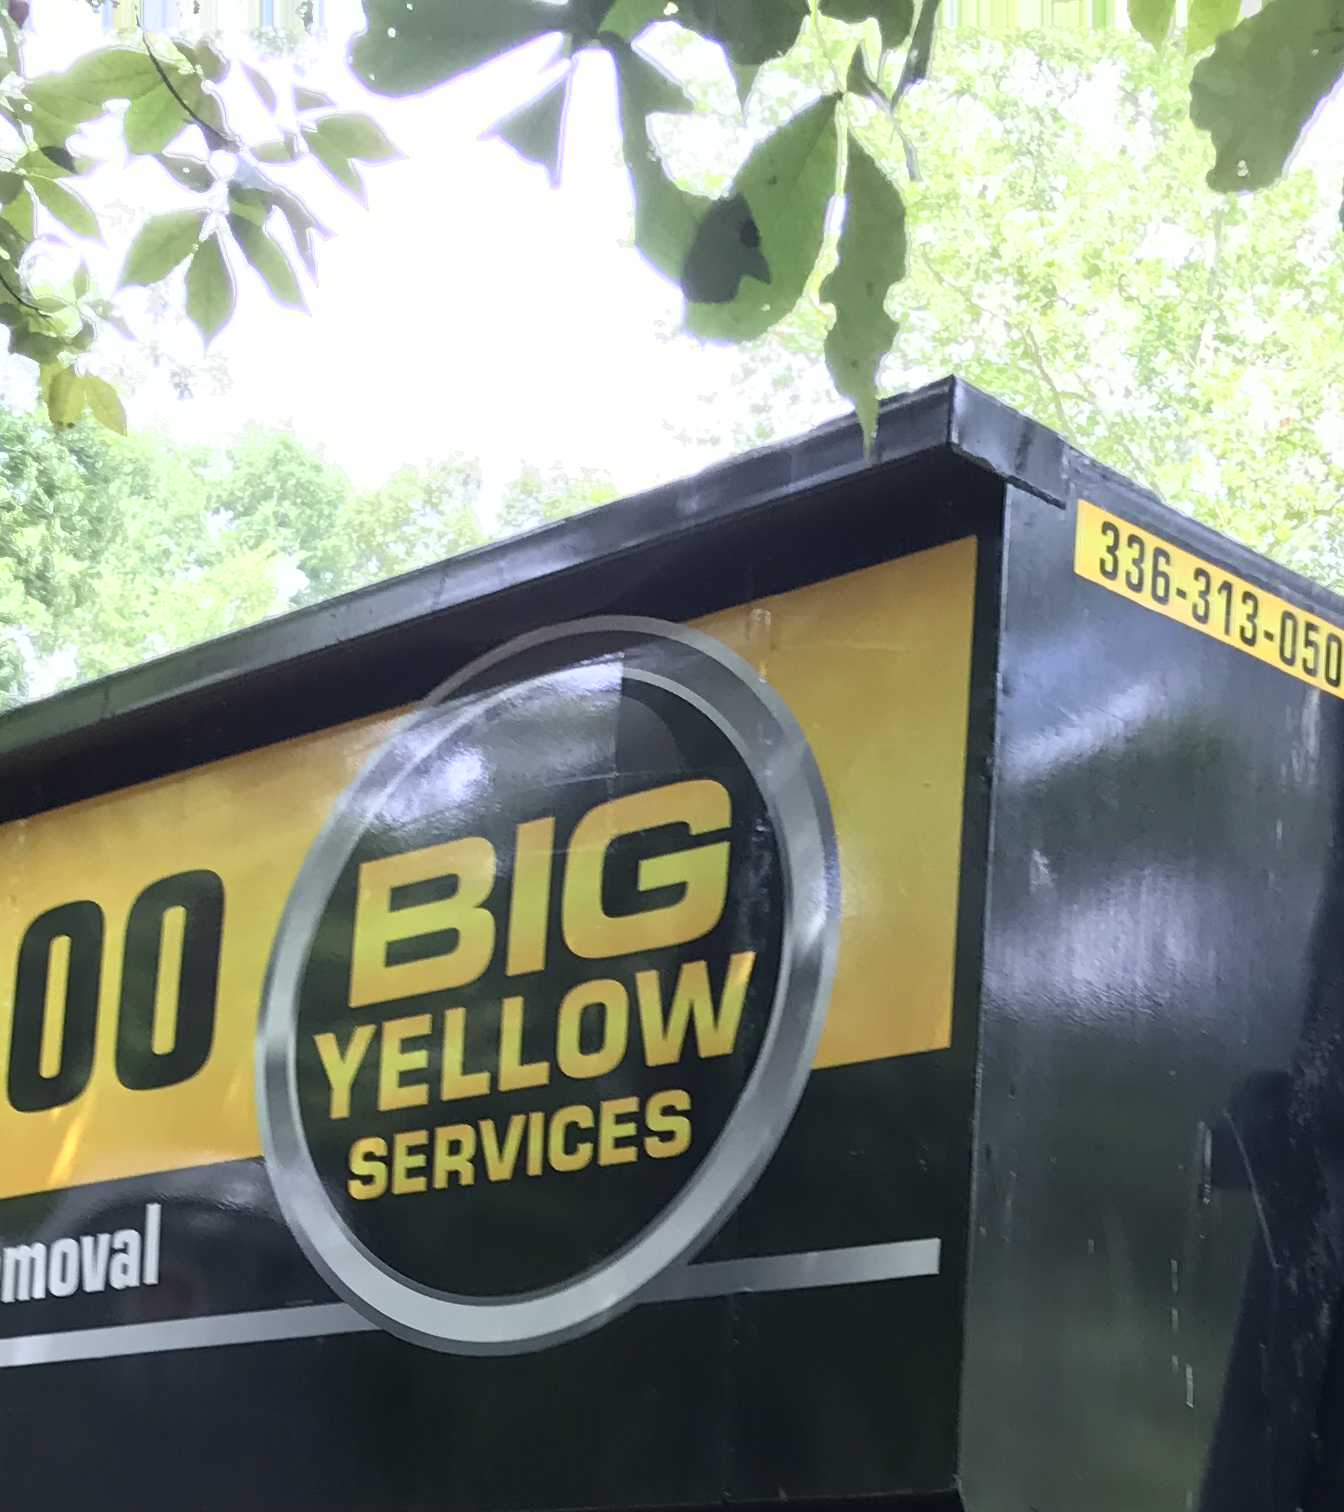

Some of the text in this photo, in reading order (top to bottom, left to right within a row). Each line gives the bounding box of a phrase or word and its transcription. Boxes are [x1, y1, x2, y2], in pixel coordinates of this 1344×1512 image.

[349, 779, 732, 1008] BIG
[314, 951, 755, 1120] YELLOW
[347, 1088, 692, 1201] SERVICES
